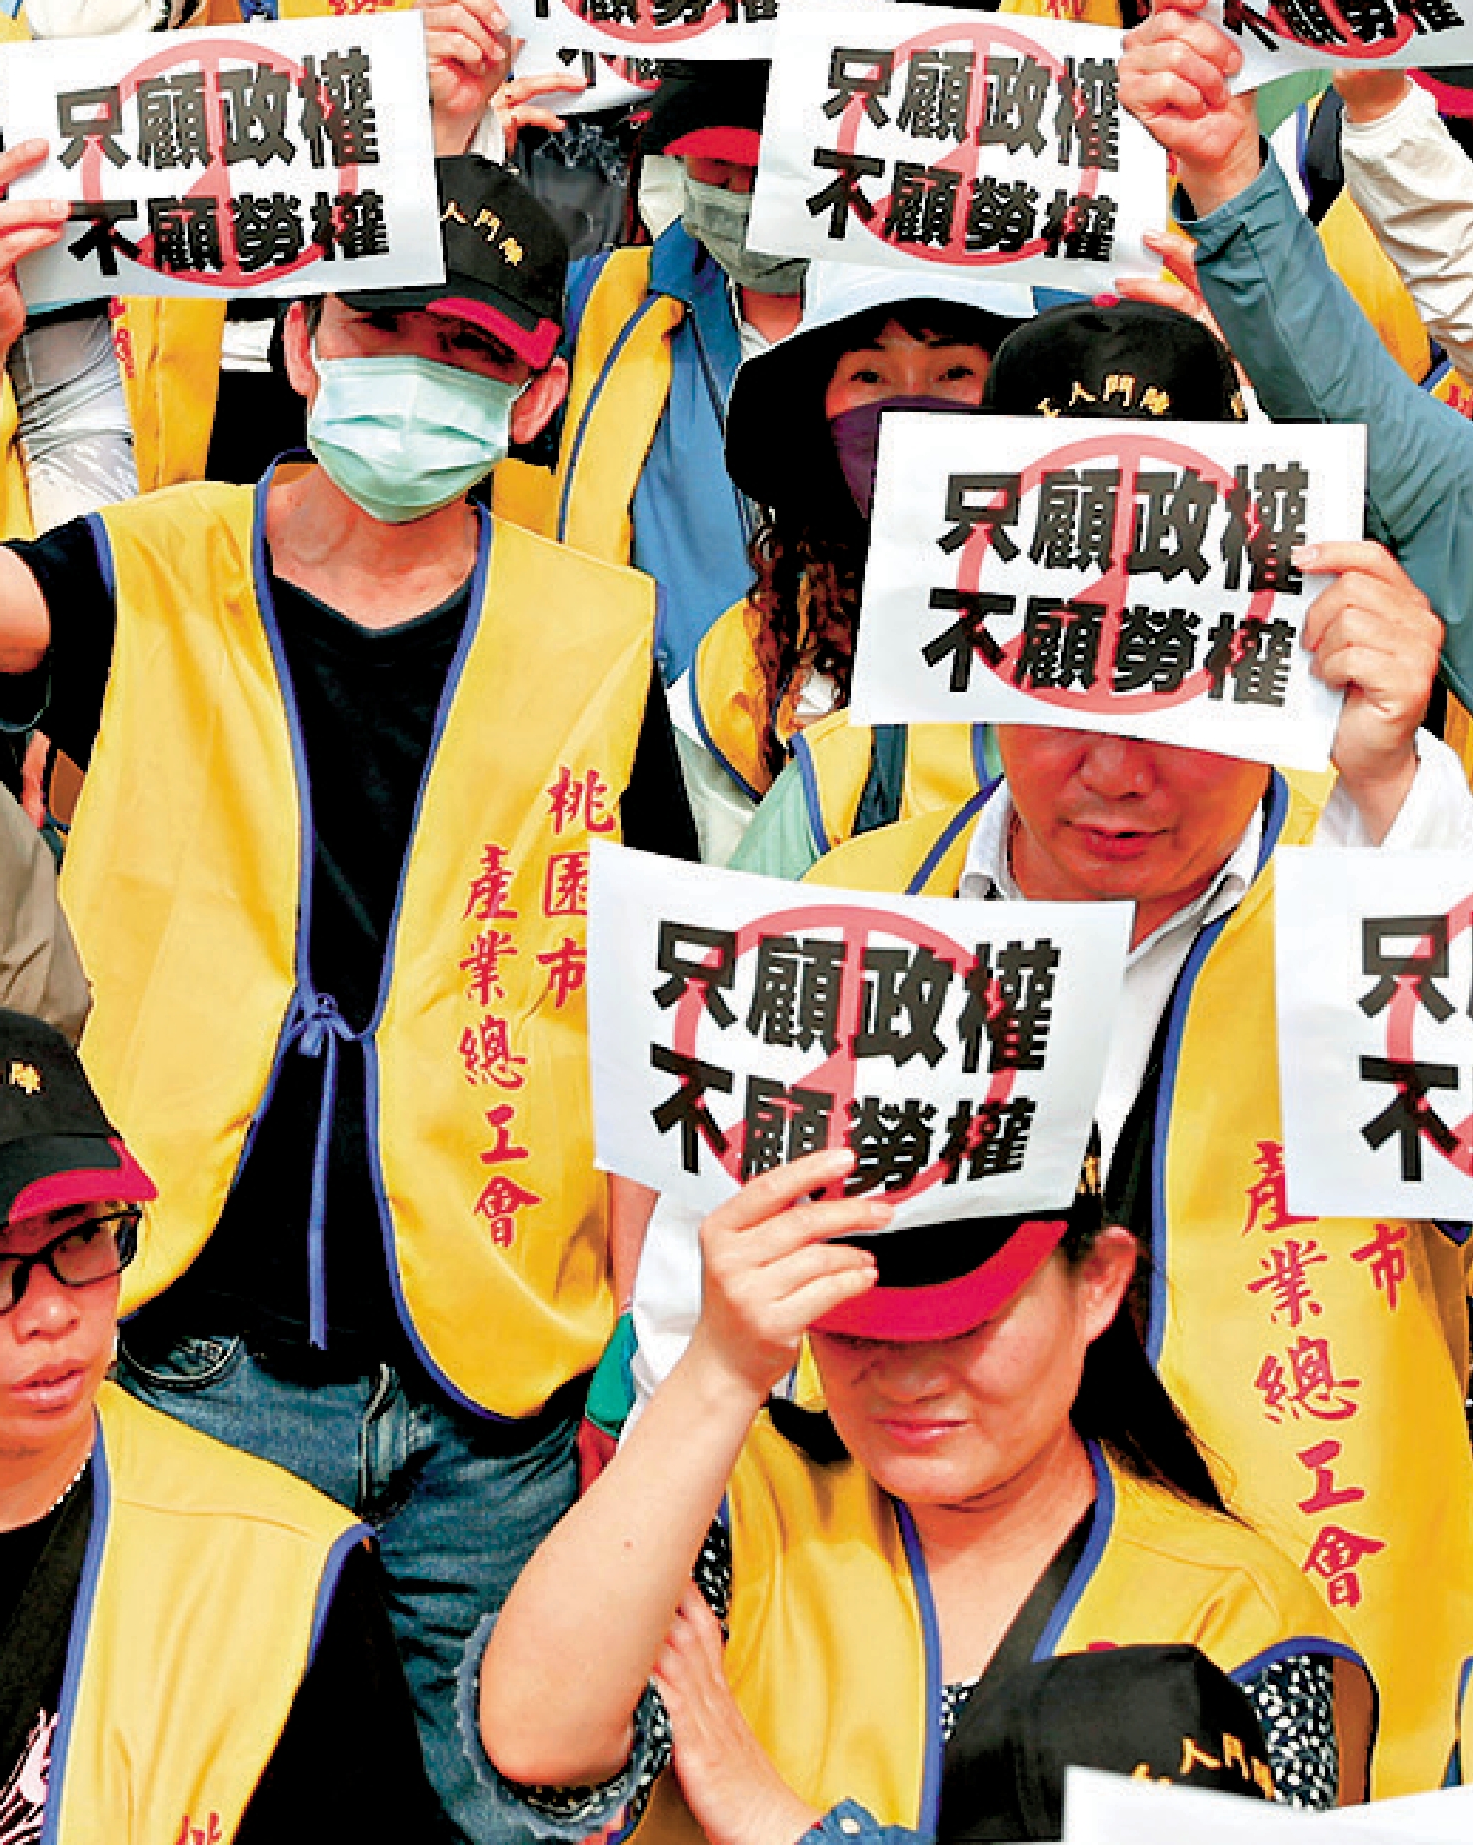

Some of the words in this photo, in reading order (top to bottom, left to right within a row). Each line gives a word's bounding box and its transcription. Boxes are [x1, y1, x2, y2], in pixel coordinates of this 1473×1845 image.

[55, 46, 380, 171] 只顧政權
[823, 45, 1122, 172] 只顧政權
[67, 190, 391, 276] 不顧勞權
[805, 148, 1119, 263] 不顧勞權
[936, 459, 1310, 595] 只顧政權
[922, 588, 1305, 709] 不顧勞權
[458, 844, 543, 1248] 產業總工會
[651, 920, 1060, 1072] 只顧政權
[650, 1043, 1038, 1197] 不顧勞權
[1243, 1141, 1387, 1609] 產業總工會
